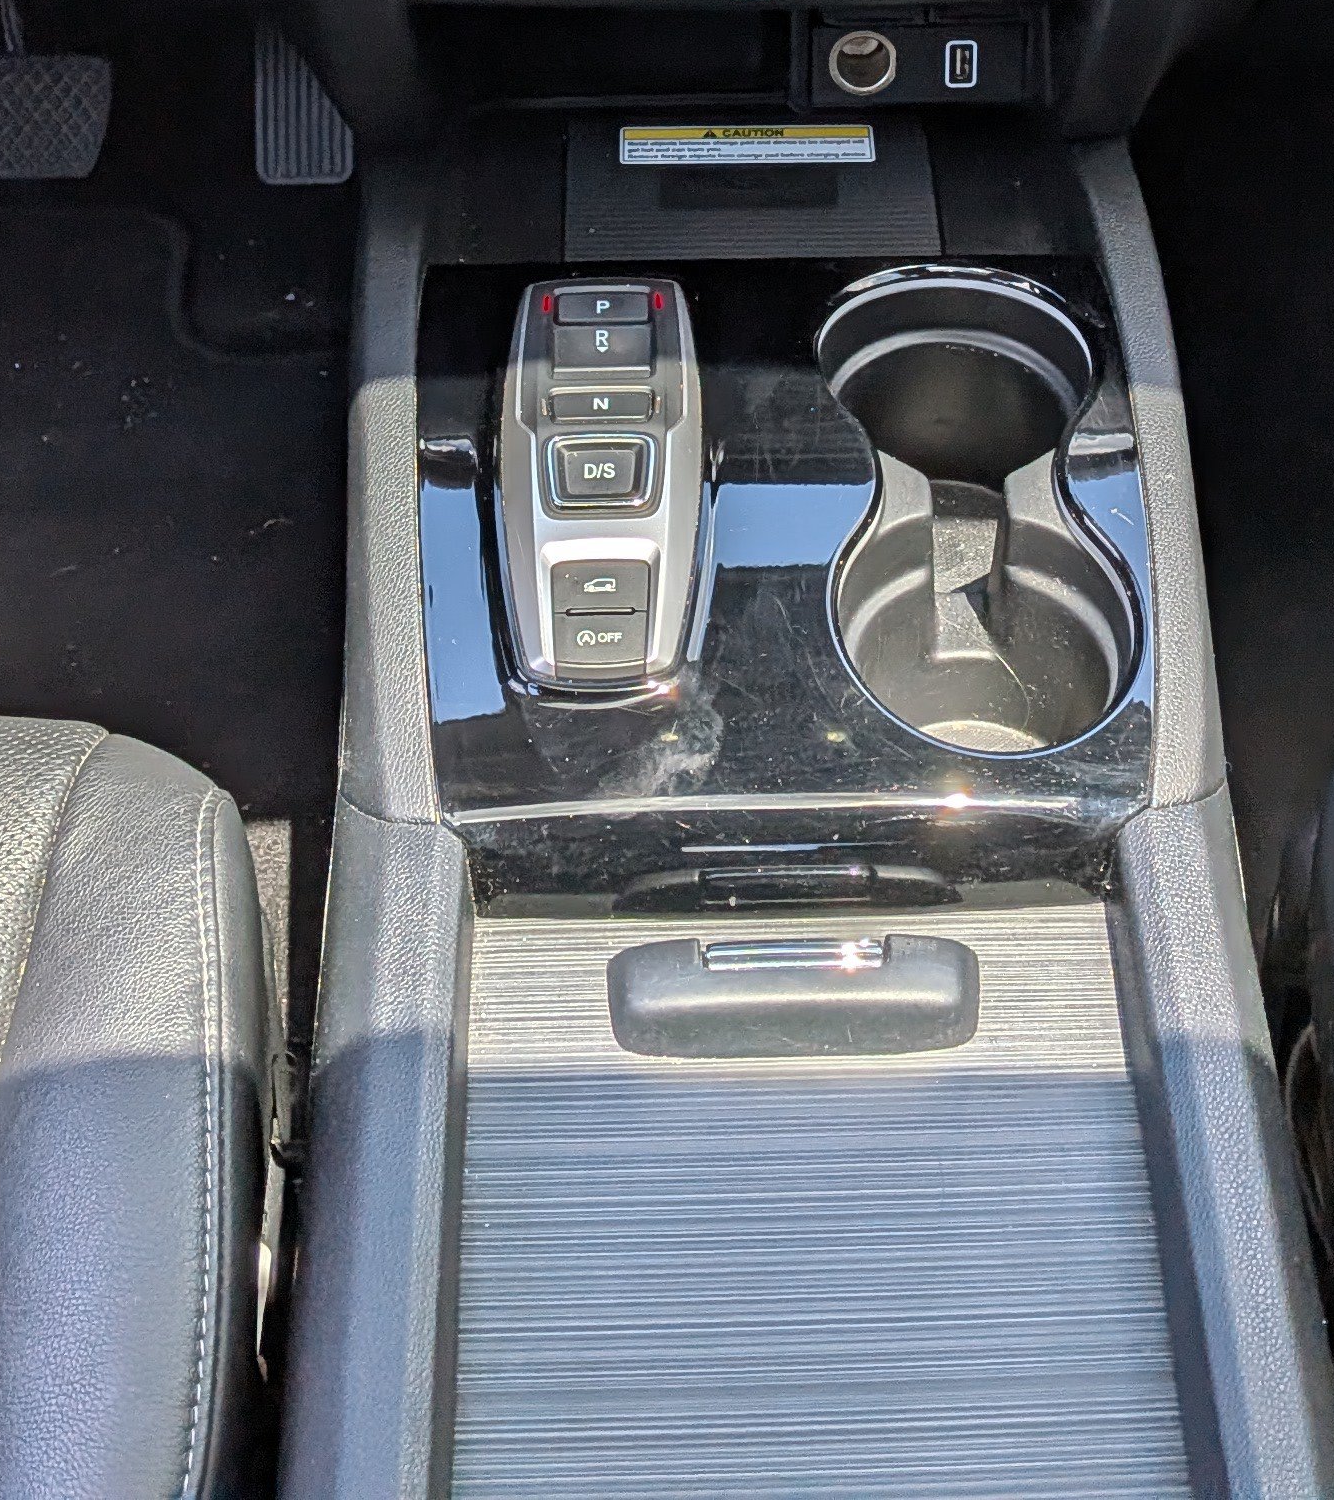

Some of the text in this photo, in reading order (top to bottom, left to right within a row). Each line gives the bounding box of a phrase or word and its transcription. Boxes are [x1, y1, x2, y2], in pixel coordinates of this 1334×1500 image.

[722, 129, 783, 137] CAUTION
[596, 300, 610, 314] P
[595, 330, 608, 346] R
[593, 398, 609, 410] N
[584, 463, 616, 479] D/S
[598, 631, 622, 643] OFF
